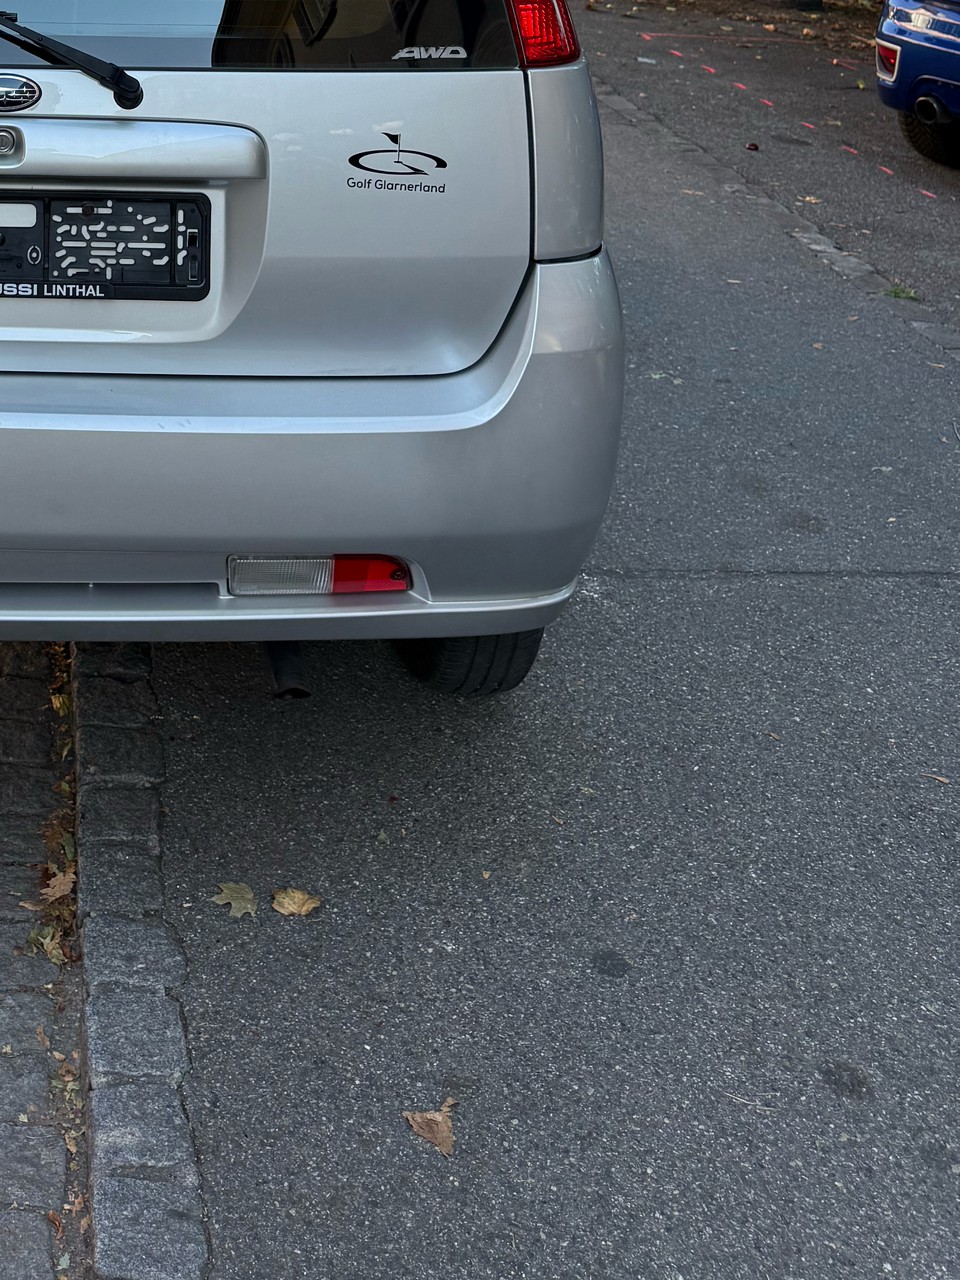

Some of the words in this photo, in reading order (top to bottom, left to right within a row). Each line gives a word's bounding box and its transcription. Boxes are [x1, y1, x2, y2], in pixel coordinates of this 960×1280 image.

[391, 46, 468, 60] AWD
[347, 177, 373, 190] Golf
[374, 179, 446, 194] Glarnerland
[43, 284, 105, 297] LINTHAL
